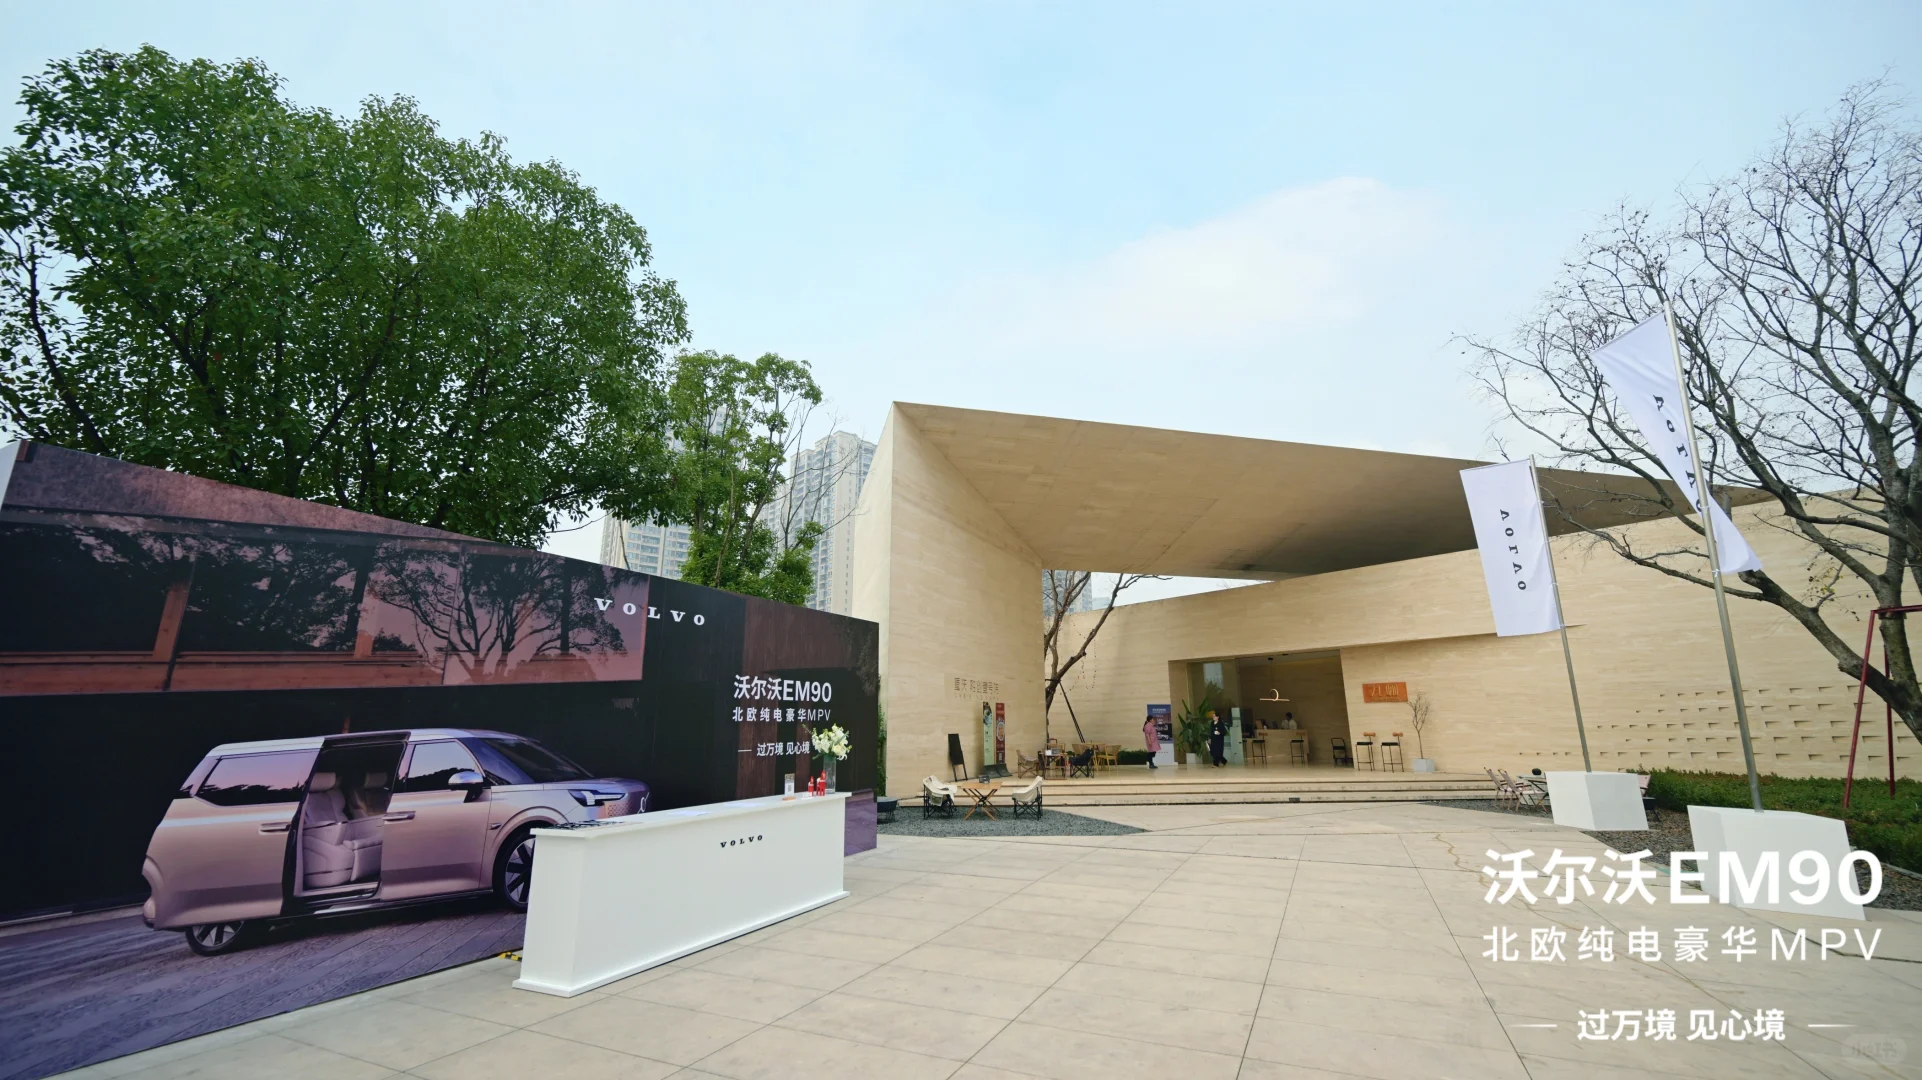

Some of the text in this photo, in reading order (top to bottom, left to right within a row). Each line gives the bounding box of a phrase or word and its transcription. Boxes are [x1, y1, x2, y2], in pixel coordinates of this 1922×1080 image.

[594, 598, 705, 625] VOLVO
[733, 674, 832, 702] 沃尔沃EM90
[732, 707, 831, 722] 北欧纯电豪华MPV
[757, 741, 810, 757] 过万境 见心境
[720, 835, 763, 848] VOLVO
